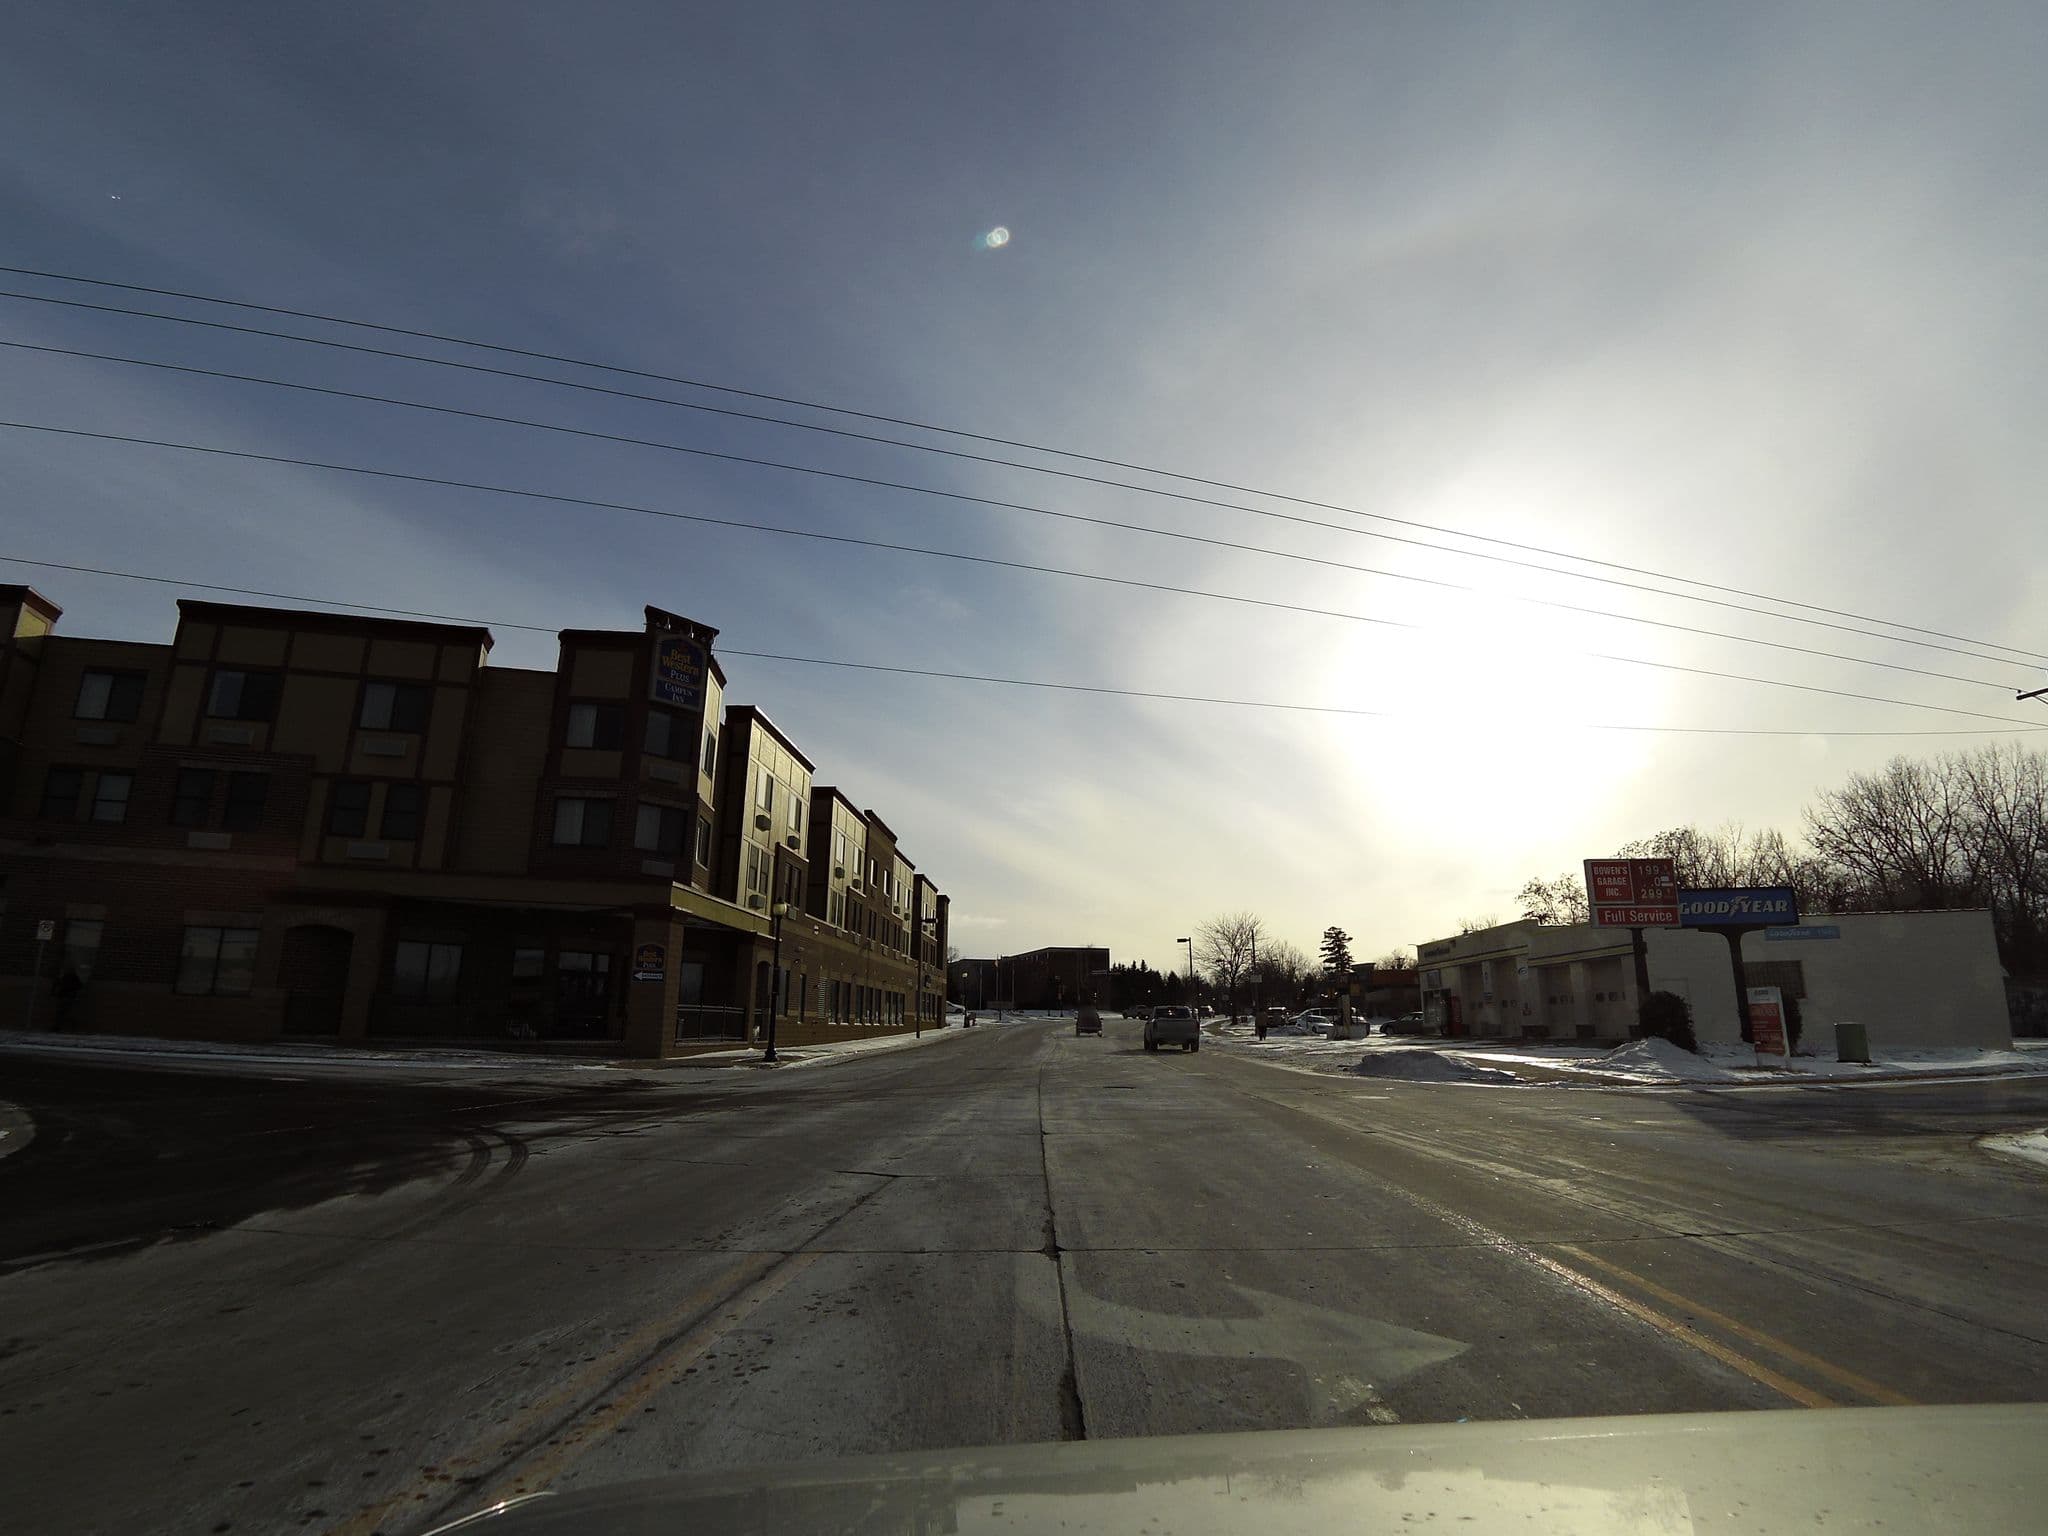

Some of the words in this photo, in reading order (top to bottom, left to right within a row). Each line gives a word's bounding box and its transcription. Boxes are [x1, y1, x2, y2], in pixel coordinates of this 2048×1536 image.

[1597, 877, 1627, 886] GARAGE
[1605, 887, 1622, 897] INC.
[1679, 897, 1789, 916] GOODYEAR
[1604, 910, 1625, 922] Full
[1629, 910, 1673, 922] Service
